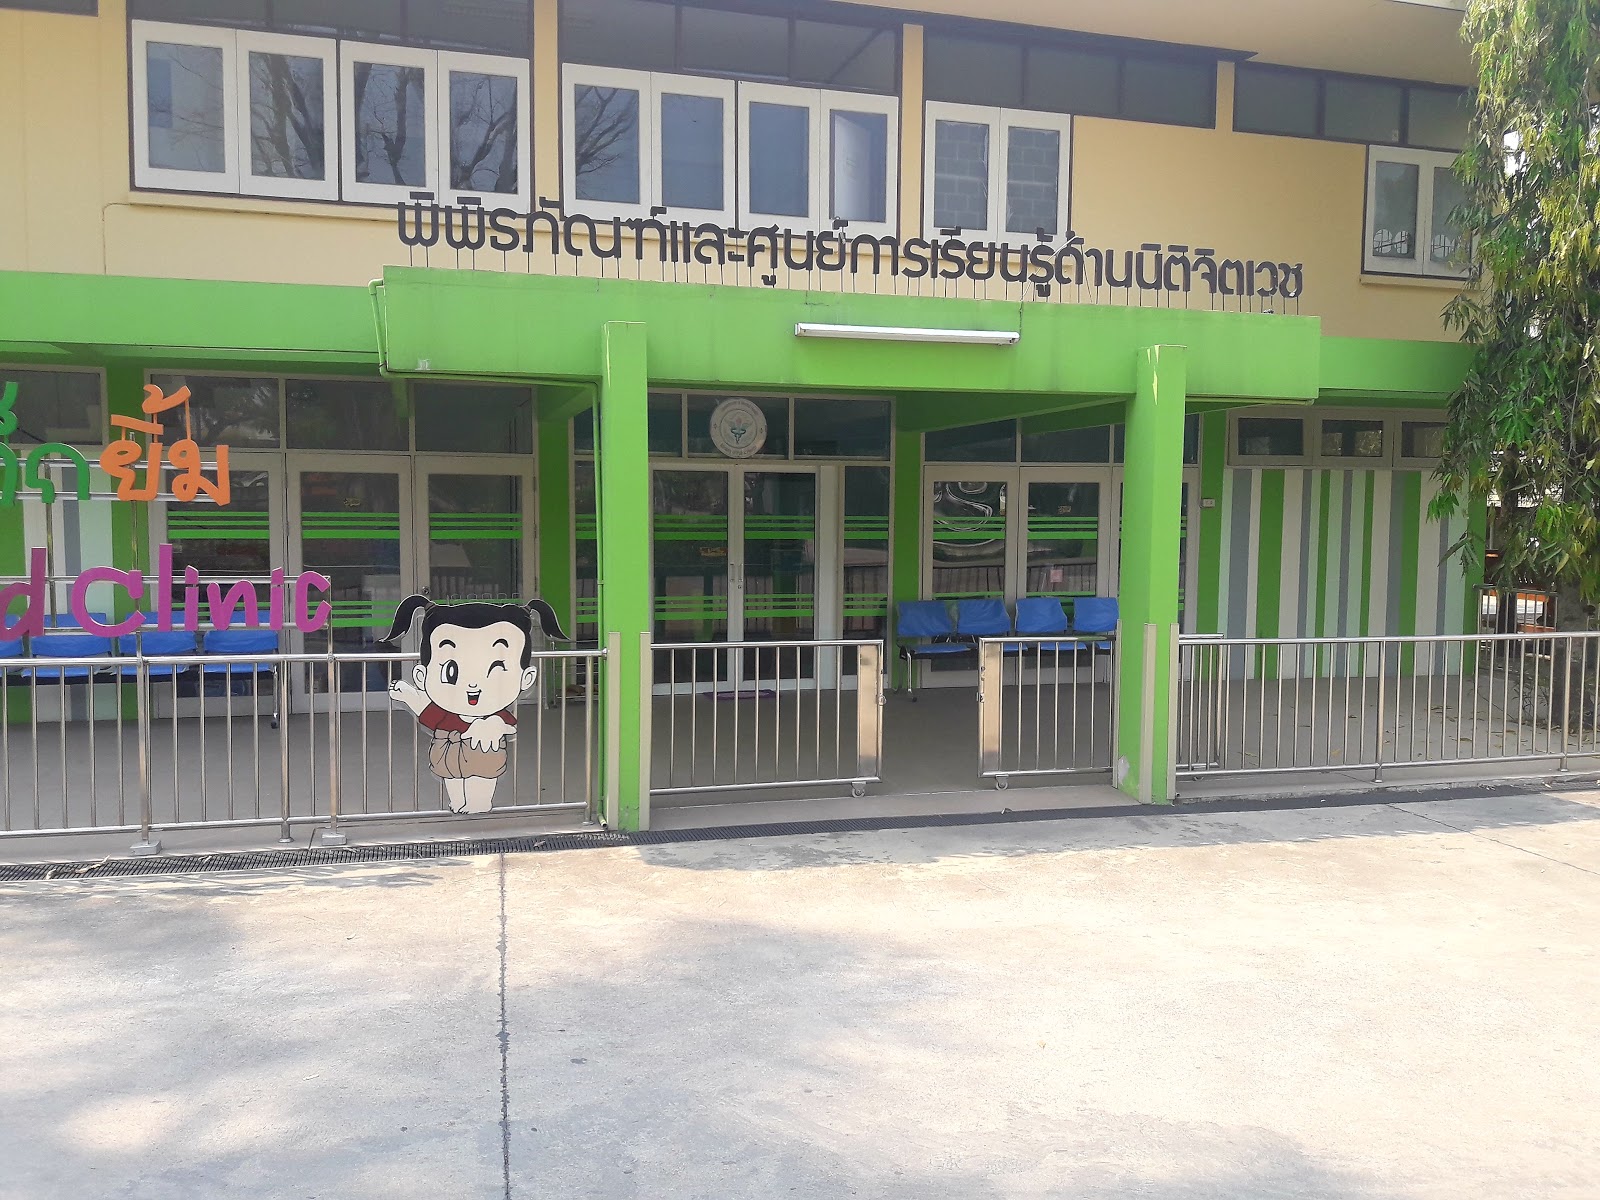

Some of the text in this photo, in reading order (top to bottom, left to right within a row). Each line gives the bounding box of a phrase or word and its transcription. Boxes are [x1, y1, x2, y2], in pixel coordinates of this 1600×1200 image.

[397, 191, 1303, 298] พิพิธภัณฑ์และศูนย์การเรียนรู้ด้านนิติจิตเวช
[72, 543, 333, 638] Clinic
